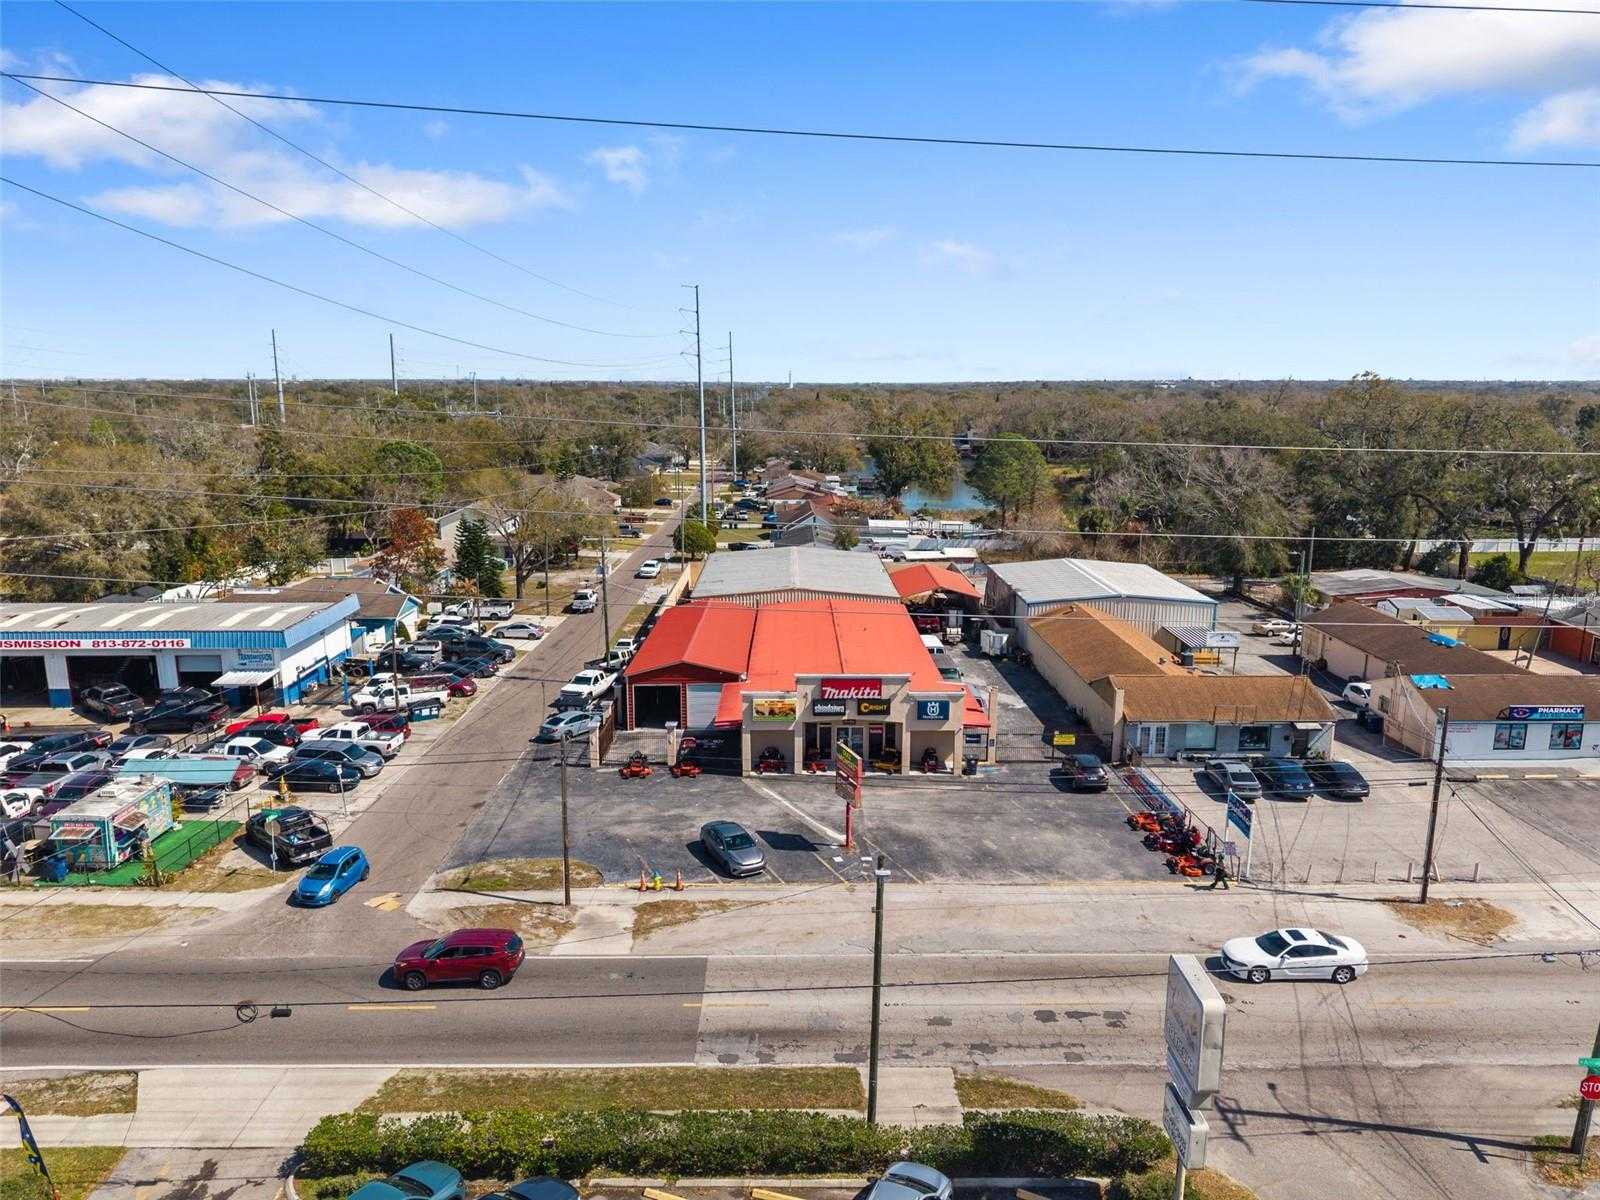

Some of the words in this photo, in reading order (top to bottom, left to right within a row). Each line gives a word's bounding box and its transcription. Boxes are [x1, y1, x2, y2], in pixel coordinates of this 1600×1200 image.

[0, 640, 81, 648] SMISSION
[91, 640, 185, 648] 813-872-0116
[1581, 1082, 1600, 1093] STO
